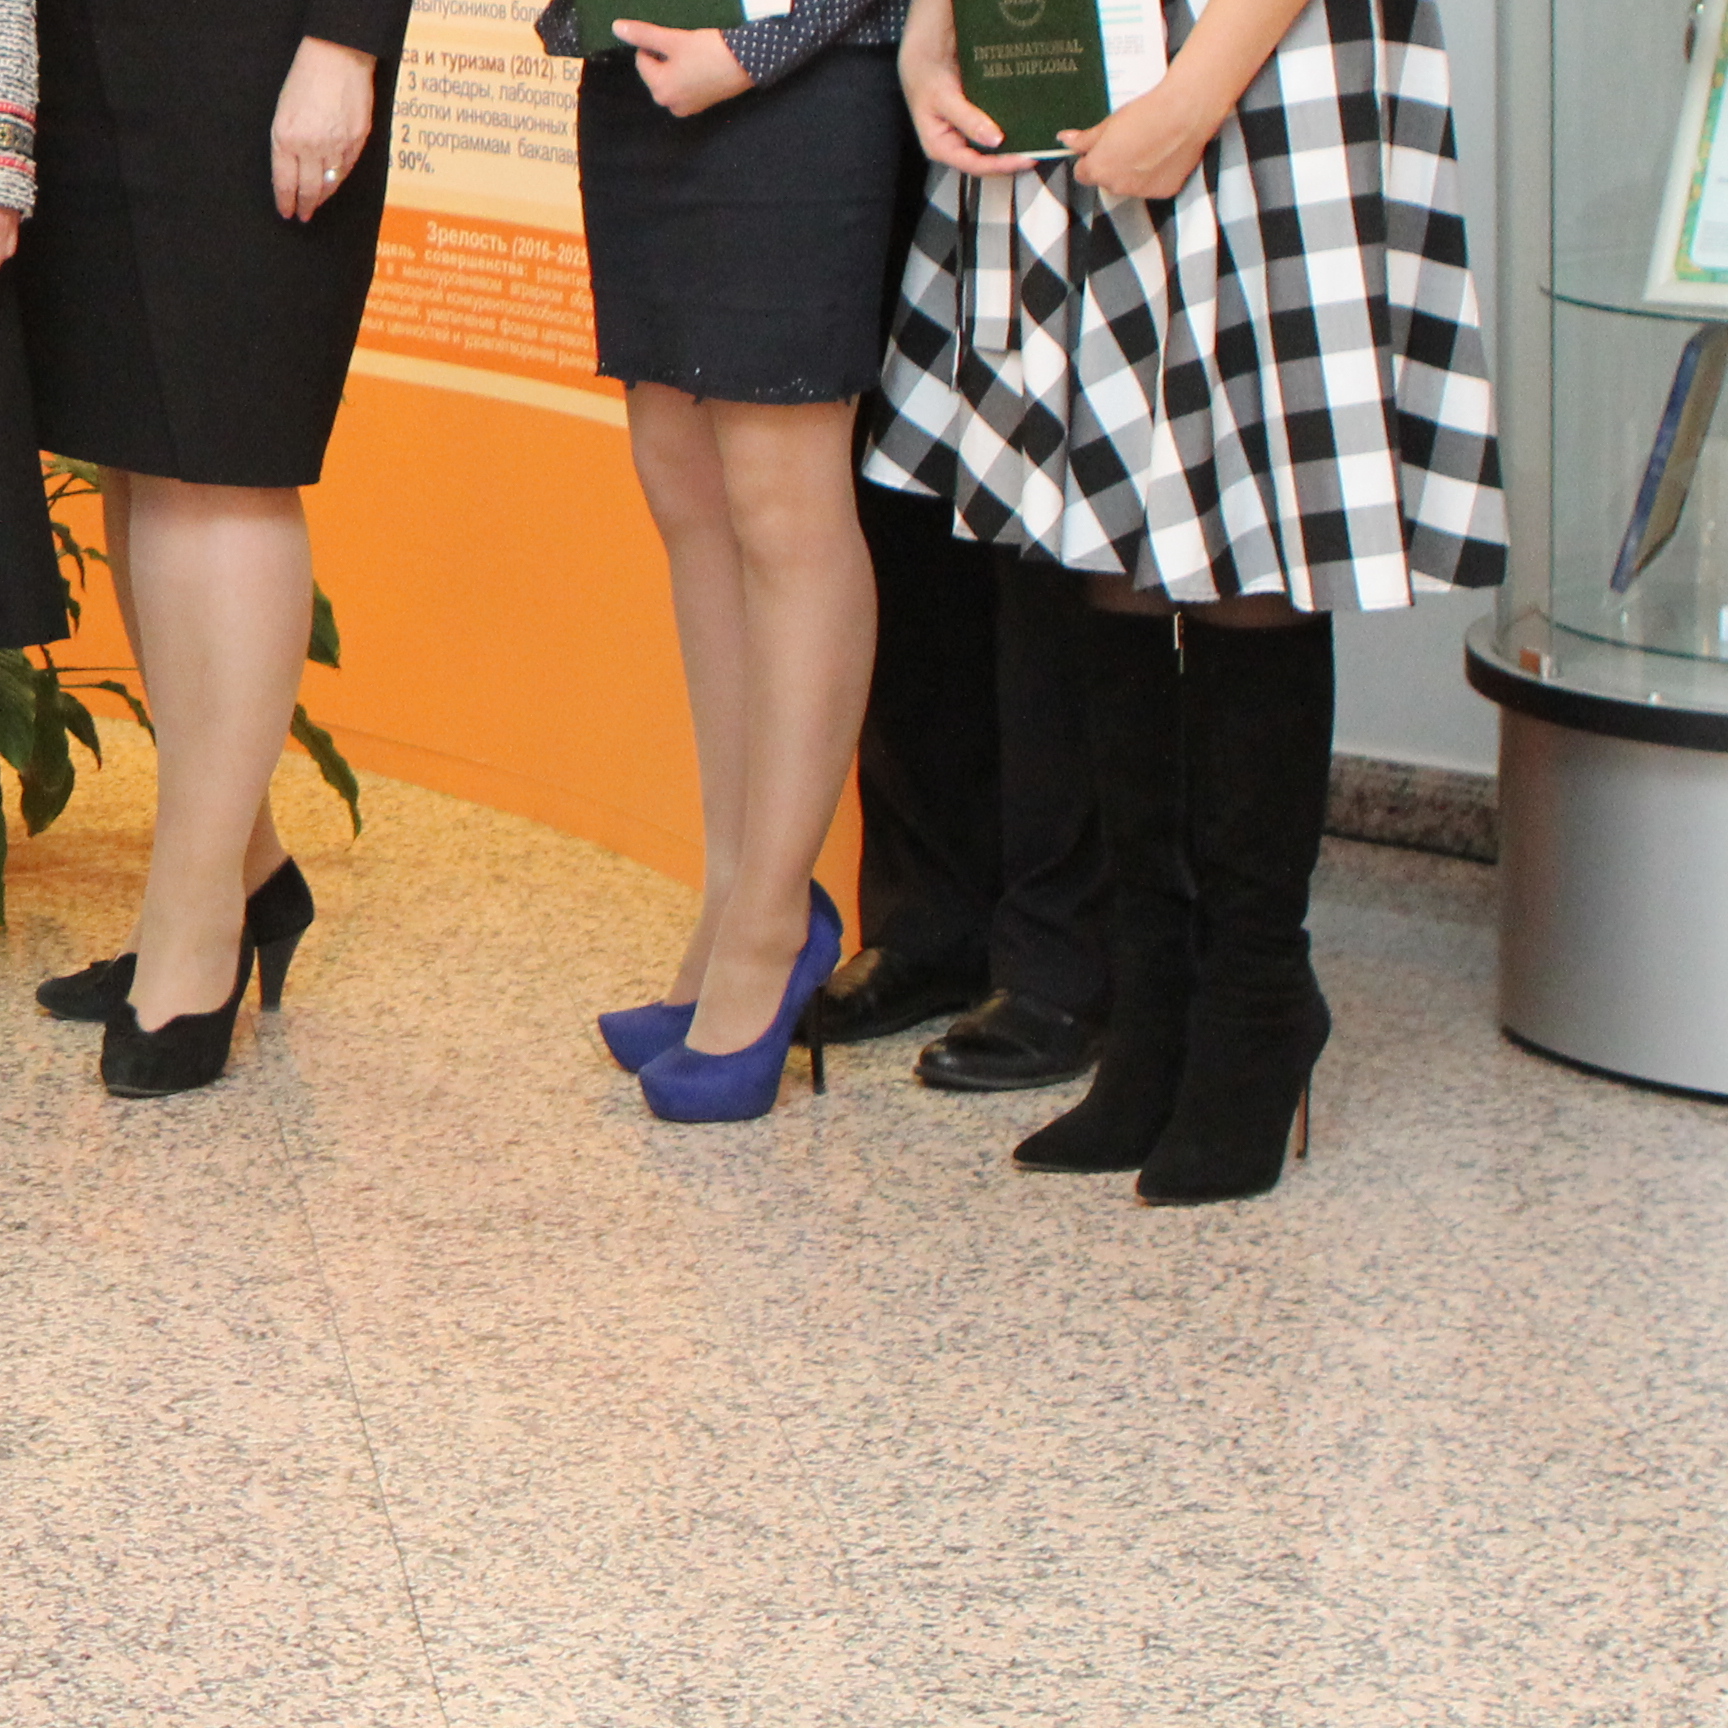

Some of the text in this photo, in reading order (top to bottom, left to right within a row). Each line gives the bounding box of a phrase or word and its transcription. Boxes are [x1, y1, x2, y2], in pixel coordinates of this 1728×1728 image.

[973, 39, 1084, 61] INTERNATIONAL
[424, 51, 557, 83] и туризма (2012).
[983, 57, 1079, 78] MBA DIPLOMA
[407, 70, 417, 92] 3
[456, 108, 568, 136] инновационных
[401, 123, 511, 155] 2 программам
[398, 149, 435, 174] 90%.
[426, 220, 508, 253] Зрелость
